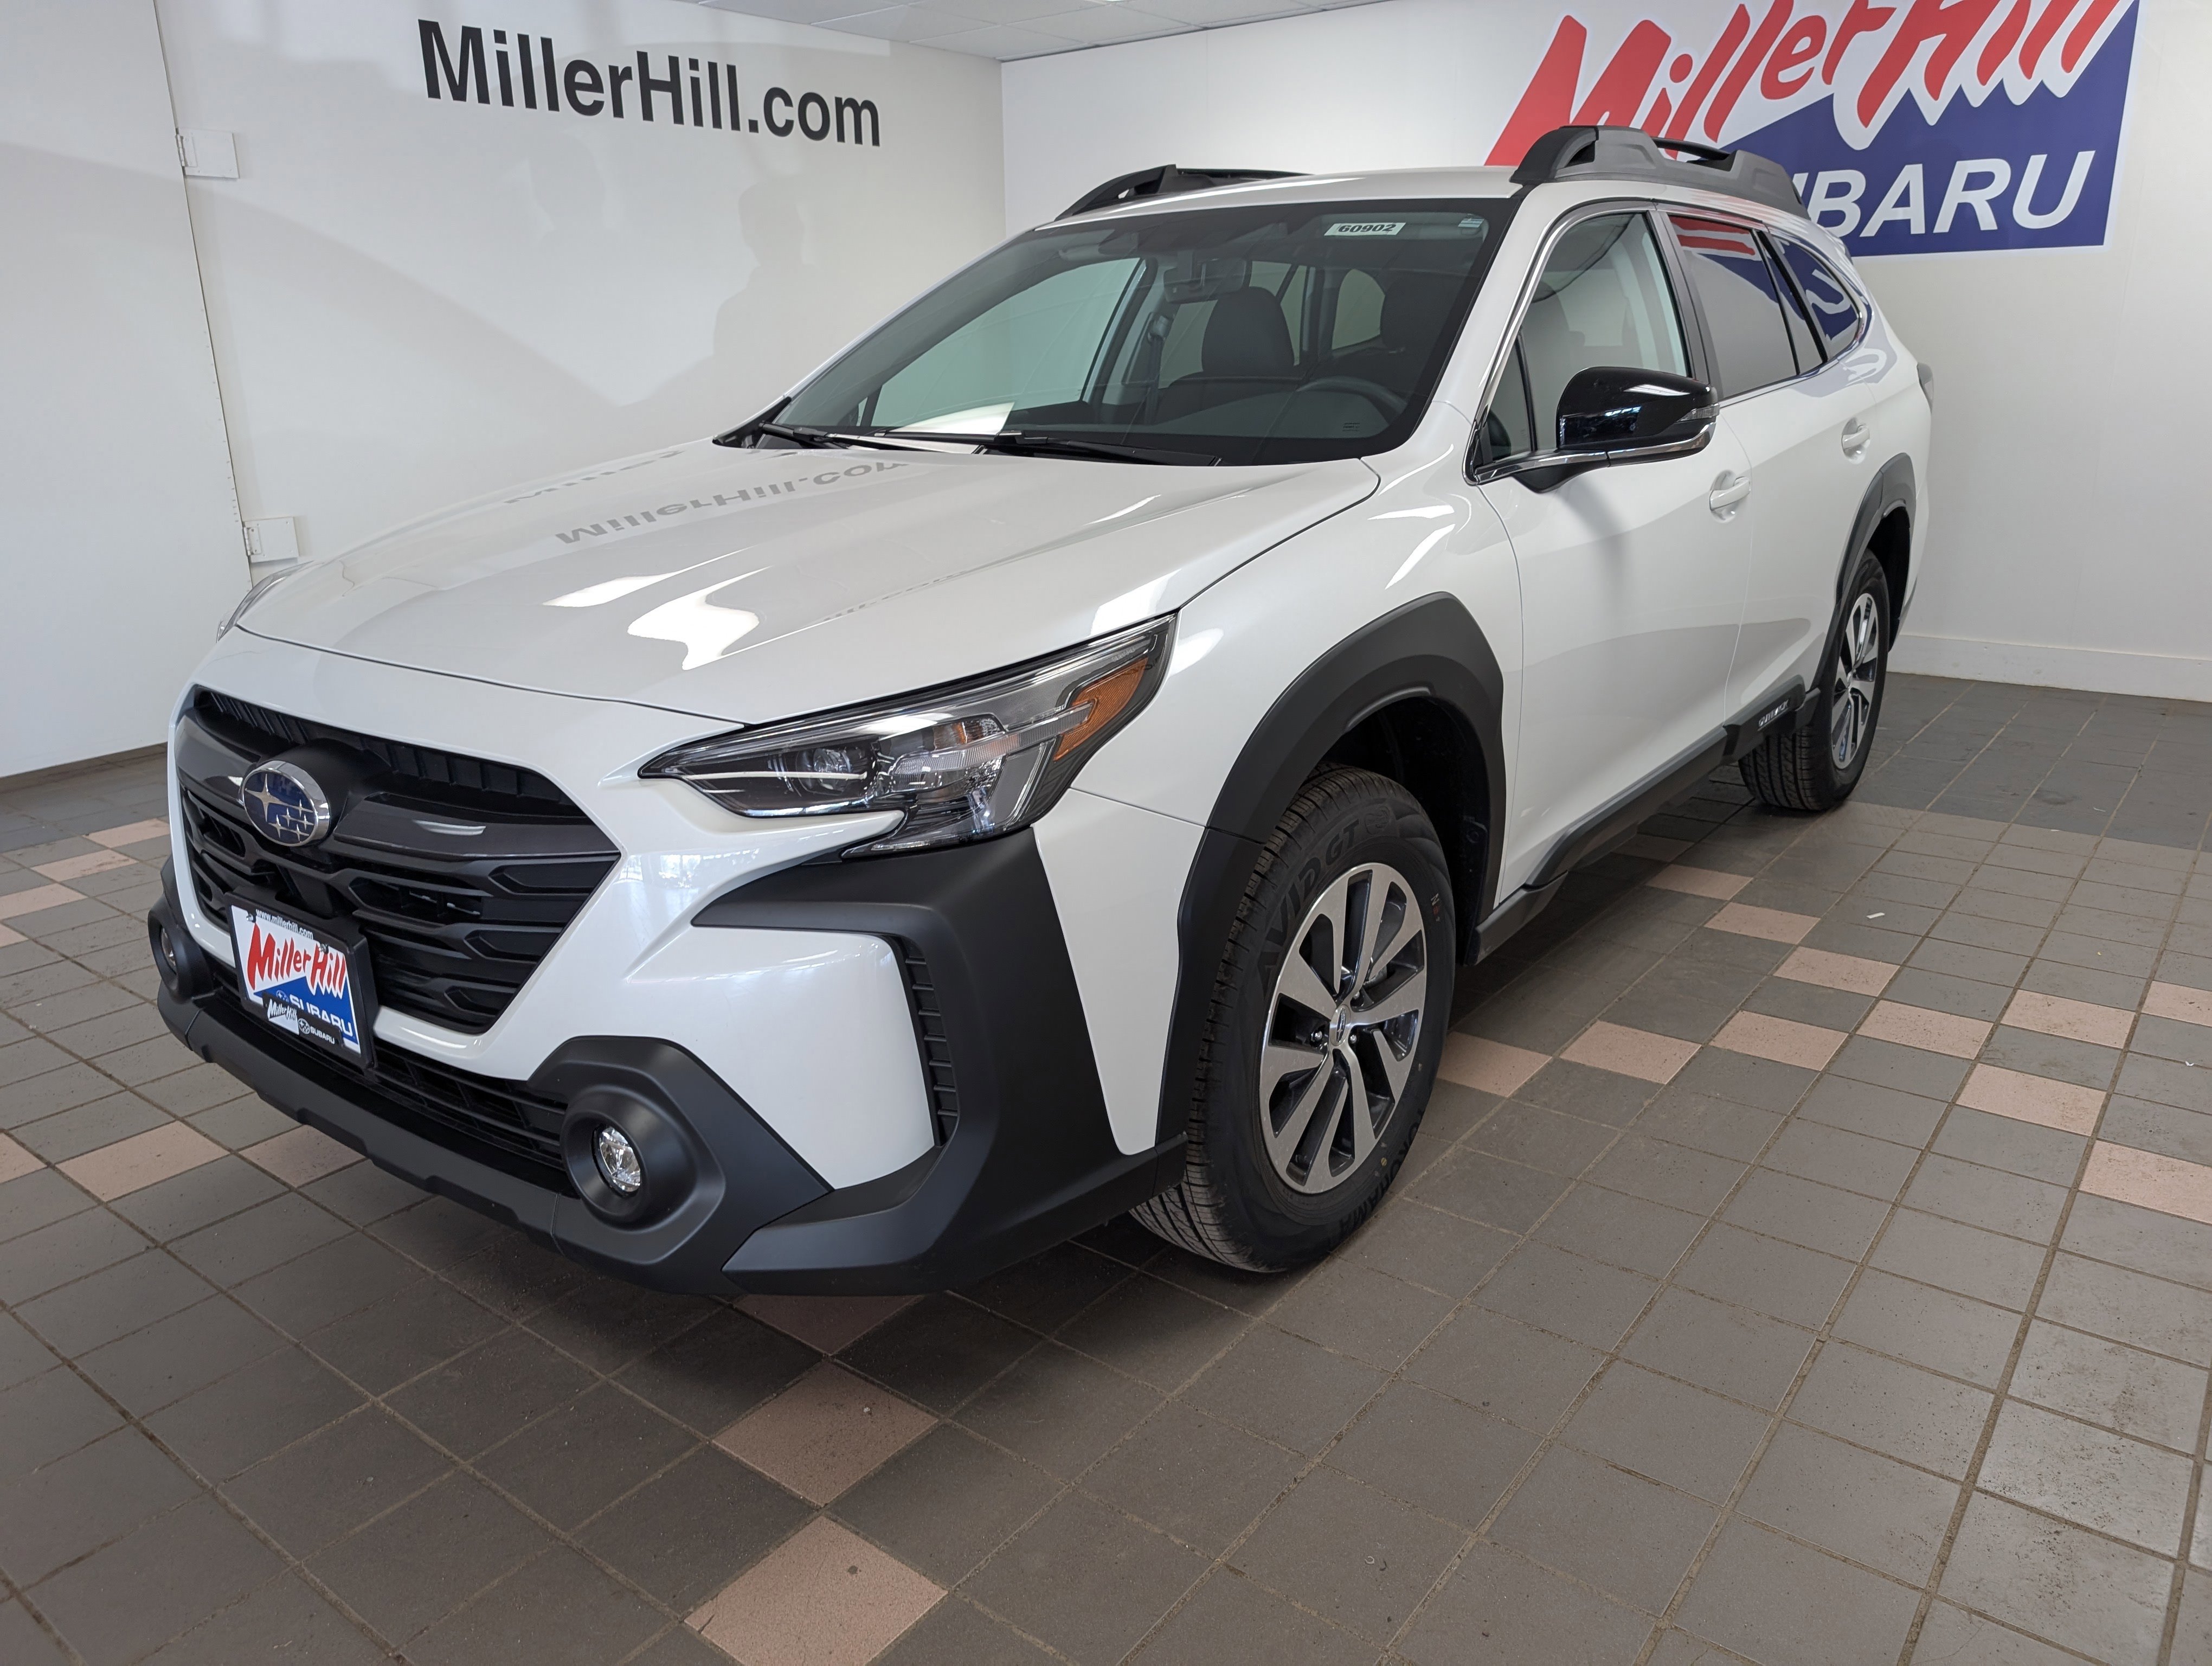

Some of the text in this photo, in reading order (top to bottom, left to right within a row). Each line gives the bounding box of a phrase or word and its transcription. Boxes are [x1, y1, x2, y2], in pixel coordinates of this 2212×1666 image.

[418, 18, 881, 148] MillerHill.com
[1792, 150, 2096, 238] BARU
[1338, 224, 1396, 232] 60902
[1326, 818, 1360, 866] GT
[255, 908, 314, 940] www.millerhill.com
[310, 1026, 335, 1045] SUBARU
